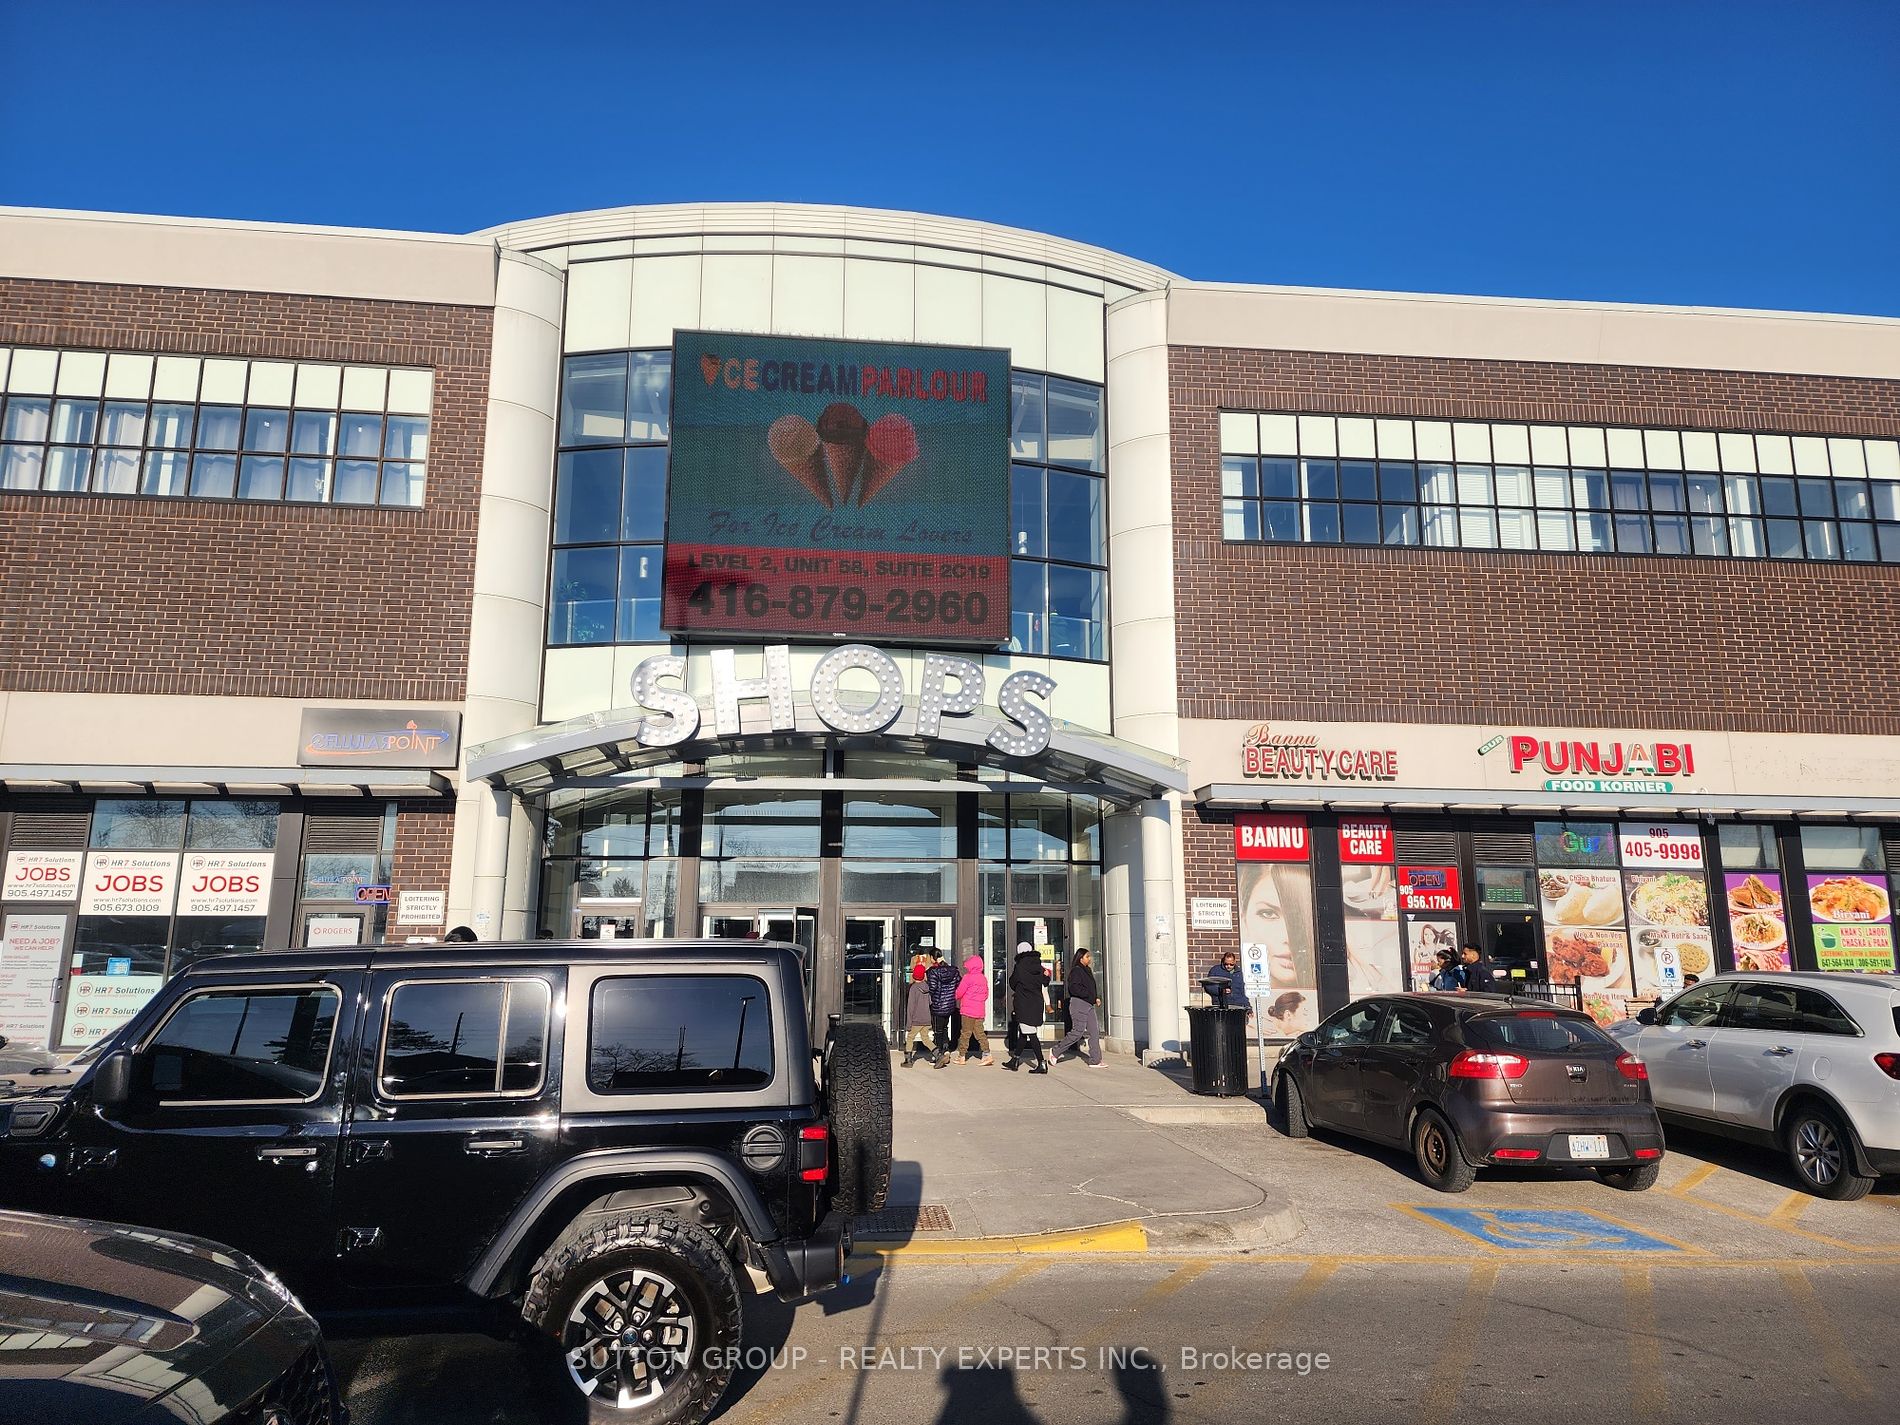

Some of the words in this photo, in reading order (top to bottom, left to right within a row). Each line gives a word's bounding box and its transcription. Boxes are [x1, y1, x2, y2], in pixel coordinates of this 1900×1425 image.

[809, 515, 886, 543] Cream
[687, 552, 752, 571] LEVEL
[759, 557, 778, 573] 2,
[784, 556, 832, 575] UNIT
[839, 558, 868, 577] 58,
[875, 560, 933, 579] SUITE
[686, 583, 990, 624] 416-879-2960
[631, 644, 1058, 757] SHOPS
[1247, 723, 1320, 747] Bannu
[1479, 734, 1504, 753] GUR
[1507, 736, 1696, 776] PUNJABI
[1243, 747, 1334, 778] BEAUTY
[1336, 750, 1400, 781] CARE
[1551, 780, 1595, 792] FOOD
[1600, 781, 1667, 793] KORNER
[1241, 825, 1304, 849] BANNU
[1342, 824, 1388, 840] BEAUTY
[1649, 828, 1669, 838] 905
[1350, 839, 1382, 855] CARE
[1625, 841, 1701, 860] 405-9998
[111, 859, 130, 867] HR7
[131, 859, 171, 867] Solutions
[227, 860, 267, 868] Solutions
[15, 867, 71, 881] JOBS
[1409, 873, 1441, 886] OPEN
[1569, 874, 1589, 882] Chana
[1591, 875, 1616, 883] Bhatura
[95, 875, 164, 892] JOBS
[192, 875, 260, 893] JOBS
[1400, 884, 1414, 895] 905
[7, 889, 73, 898] 905.497.1457
[356, 887, 391, 901] OPEN
[93, 903, 160, 912] 905.673.0109
[190, 903, 256, 912] 905.497.1457
[1407, 896, 1453, 909] 956.1704
[1833, 910, 1870, 920] Biryani
